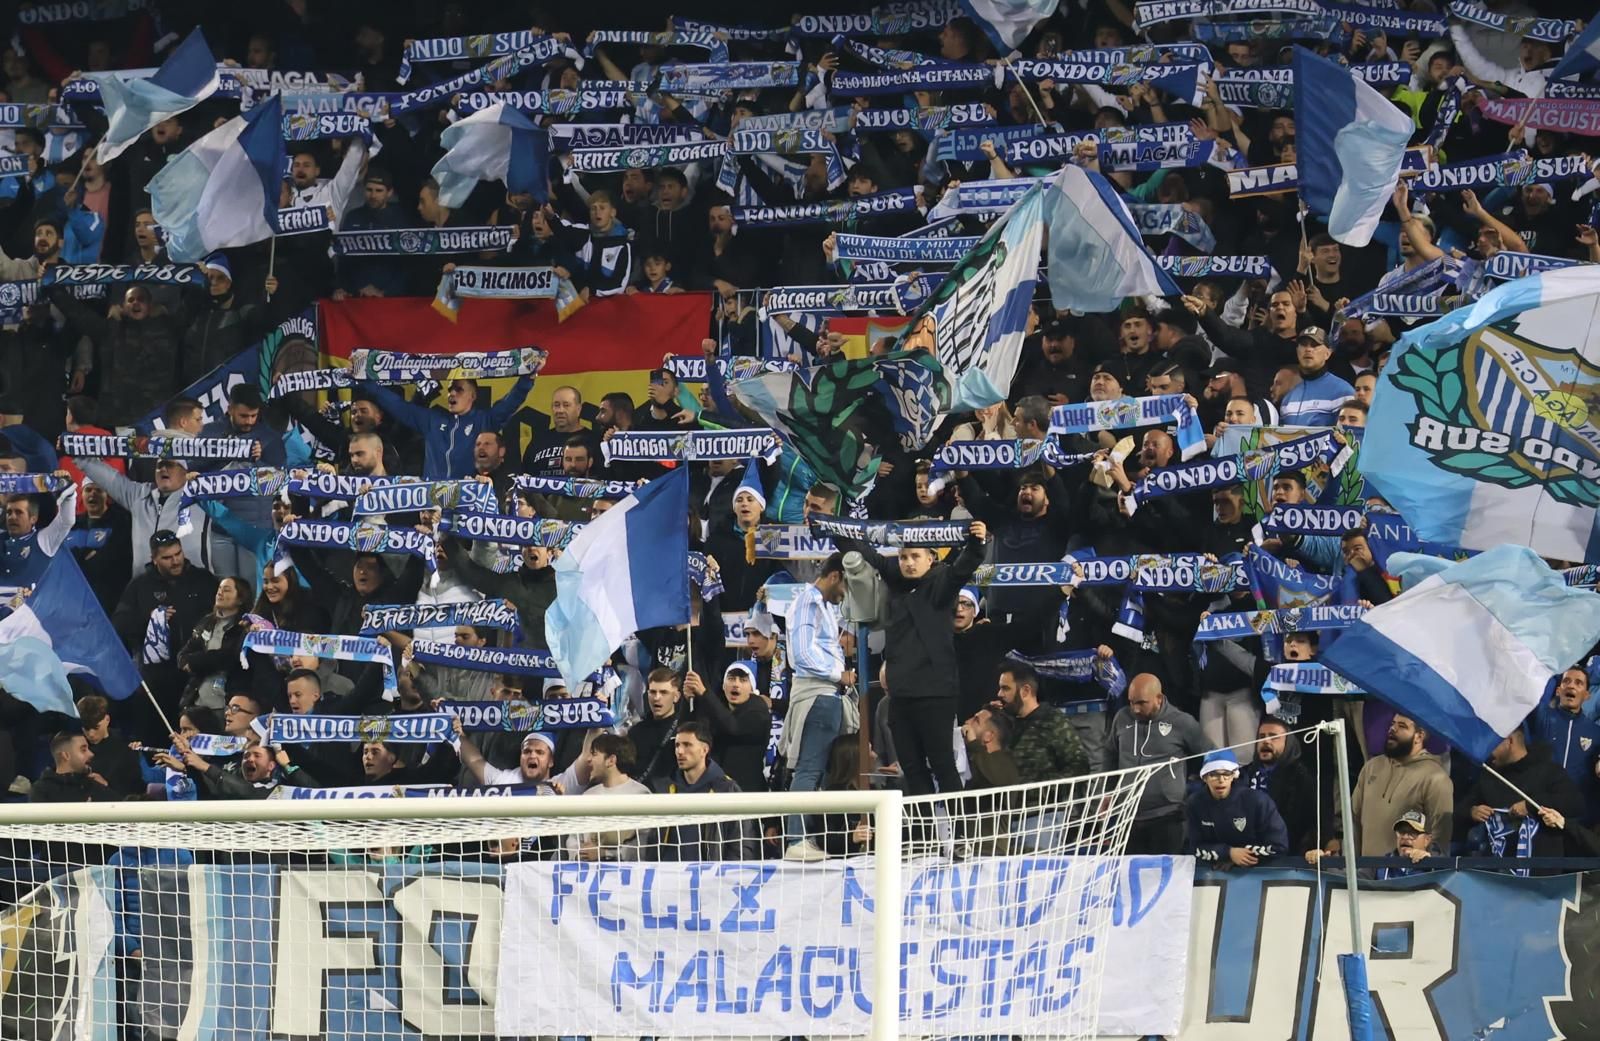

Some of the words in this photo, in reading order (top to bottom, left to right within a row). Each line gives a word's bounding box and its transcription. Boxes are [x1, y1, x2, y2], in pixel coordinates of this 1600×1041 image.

[19, 6, 88, 24] ONDO
[1139, 1, 1202, 21] RENTE
[801, 15, 872, 33] ONDO
[1016, 60, 1105, 81] FONDO
[320, 115, 371, 135] SUR
[572, 151, 621, 170] RENTE
[1422, 162, 1497, 188] ONDO
[1537, 155, 1588, 178] SUR
[857, 191, 905, 214] SUR
[839, 236, 868, 248] MUY
[870, 238, 912, 249] NOBLE
[914, 240, 925, 249] Y
[899, 249, 917, 260] DE
[1212, 255, 1266, 274] SUR
[55, 264, 130, 283] DESDE
[133, 264, 194, 284] 1986
[480, 270, 551, 290] HICIMOS!
[373, 352, 461, 376] Malaguismo
[461, 357, 480, 369] en
[482, 356, 516, 369] vena
[63, 434, 128, 456] FRENTE
[937, 442, 1015, 467] ONDO
[182, 472, 251, 498] ONDO
[1142, 459, 1239, 495] FONDO
[362, 485, 428, 513] ONDO
[452, 513, 534, 541] FONDO
[1267, 506, 1361, 532] FONDO
[281, 521, 350, 545] ONDO
[902, 523, 964, 544] BOKERÓN
[1368, 522, 1412, 543] ANT
[996, 565, 1058, 584] SUR
[361, 601, 450, 631] DEFIENDE
[543, 700, 602, 727] SUR
[270, 714, 354, 741] FONDO
[393, 717, 450, 742] SUR
[551, 863, 777, 933] FELIZ
